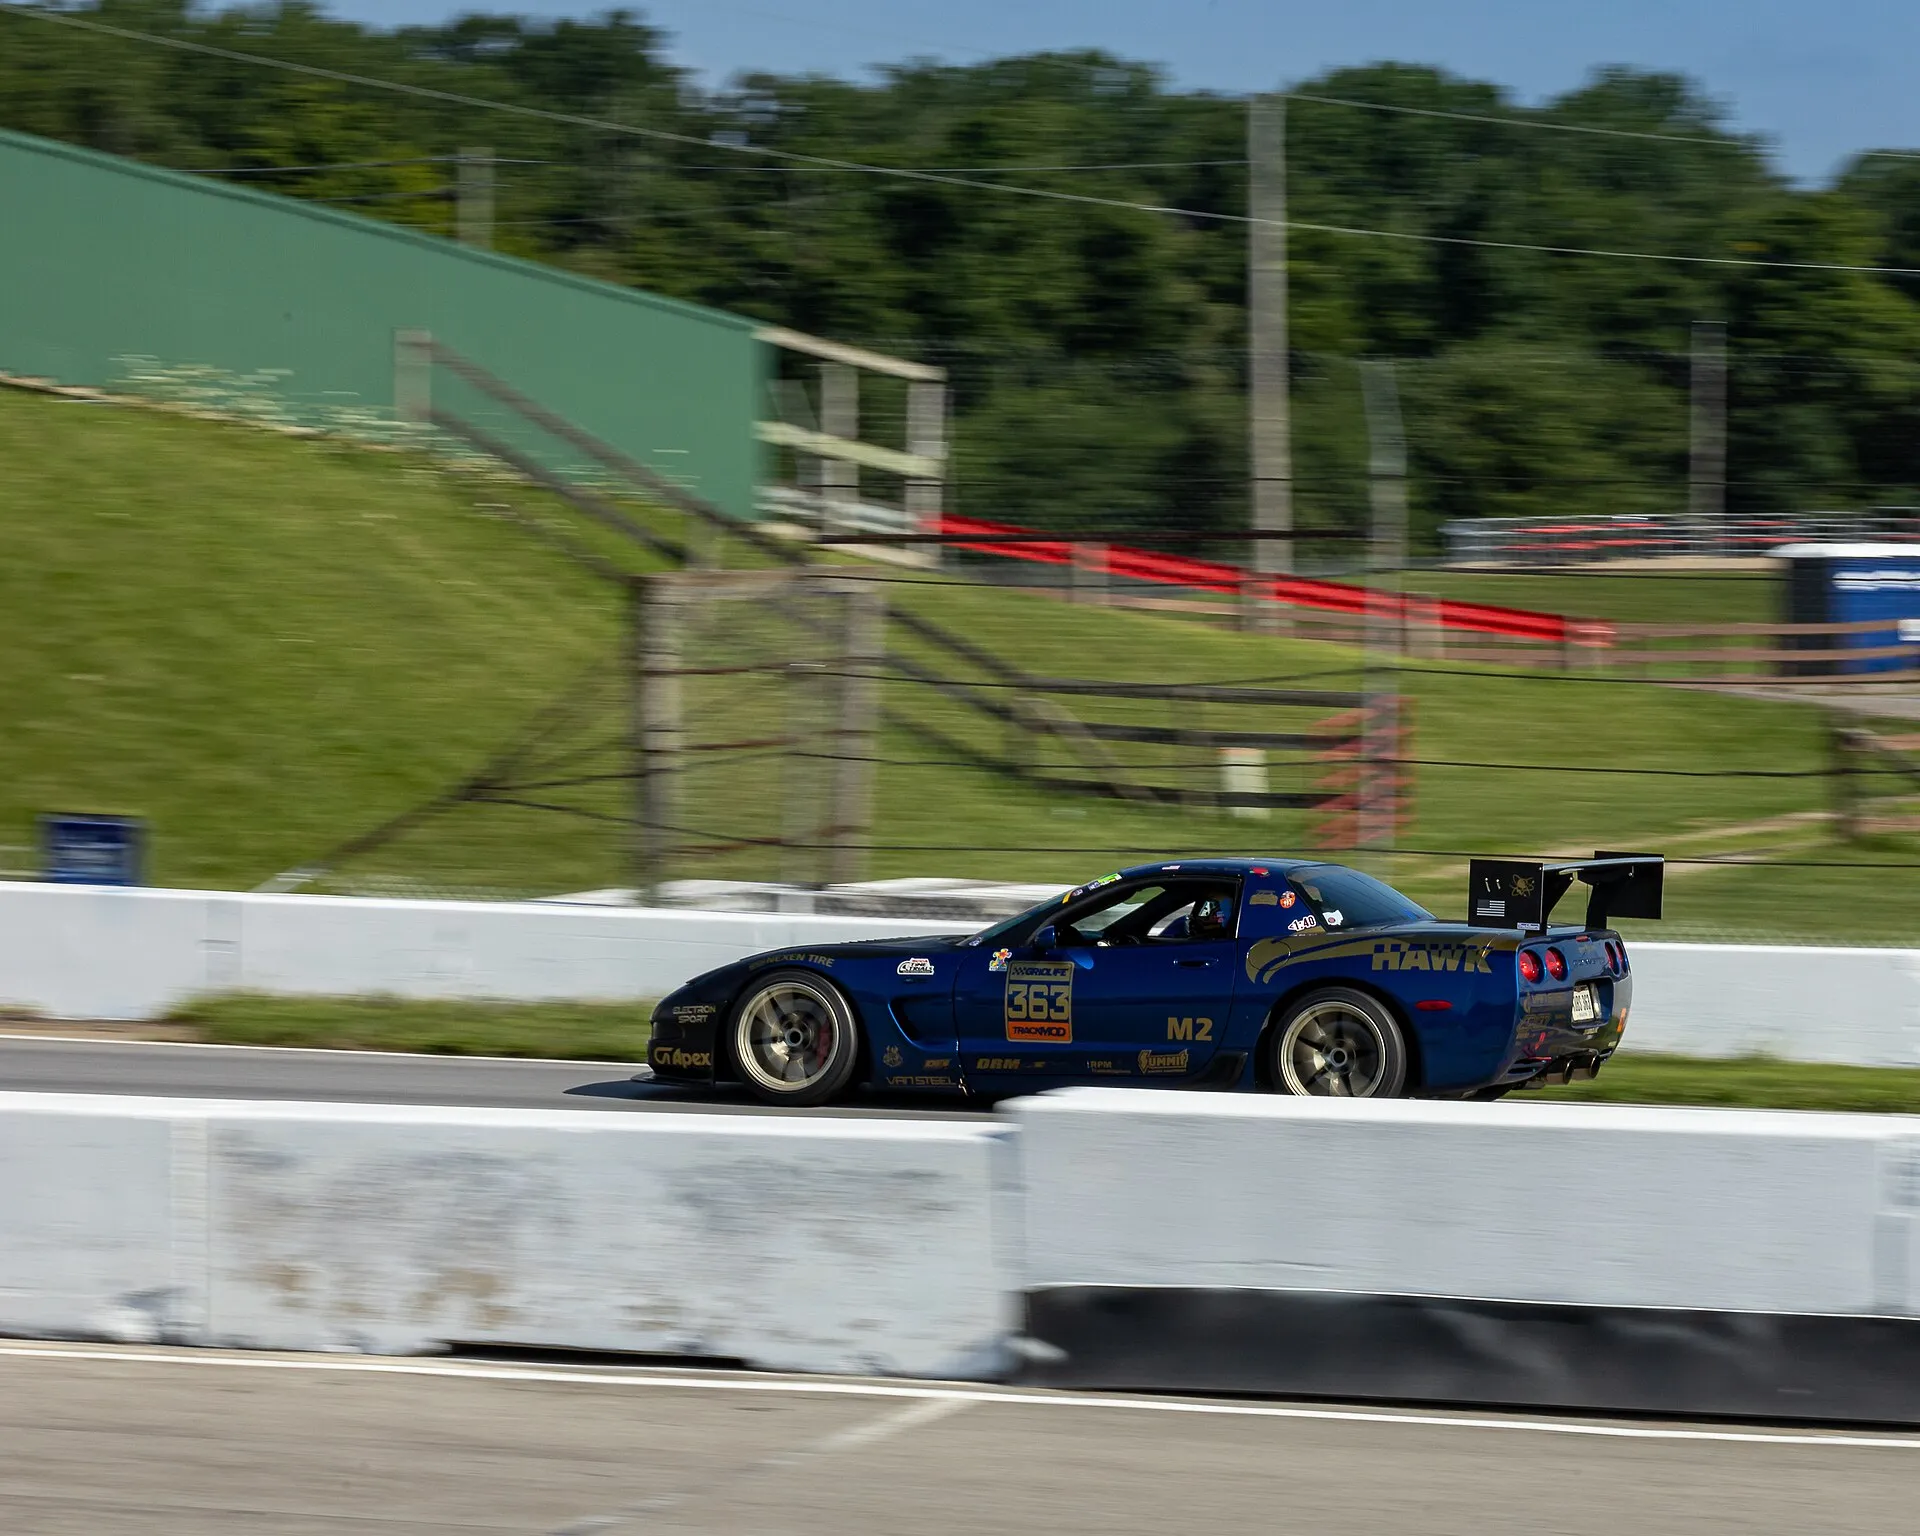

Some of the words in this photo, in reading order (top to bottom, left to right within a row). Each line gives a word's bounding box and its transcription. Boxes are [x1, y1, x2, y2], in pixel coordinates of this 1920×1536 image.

[808, 954, 836, 968] TIRE
[1372, 943, 1493, 973] HAWK
[1025, 967, 1069, 976] GRIDLIFE
[1008, 984, 1069, 1020] 363
[672, 1005, 716, 1015] ELECTRON
[678, 1014, 708, 1023] SPORT
[1012, 1026, 1066, 1036] TRACKMOD
[1167, 1017, 1213, 1041] M2
[672, 1047, 712, 1069] Apex
[975, 1057, 1022, 1069] DRM
[1090, 1060, 1112, 1069] RPM
